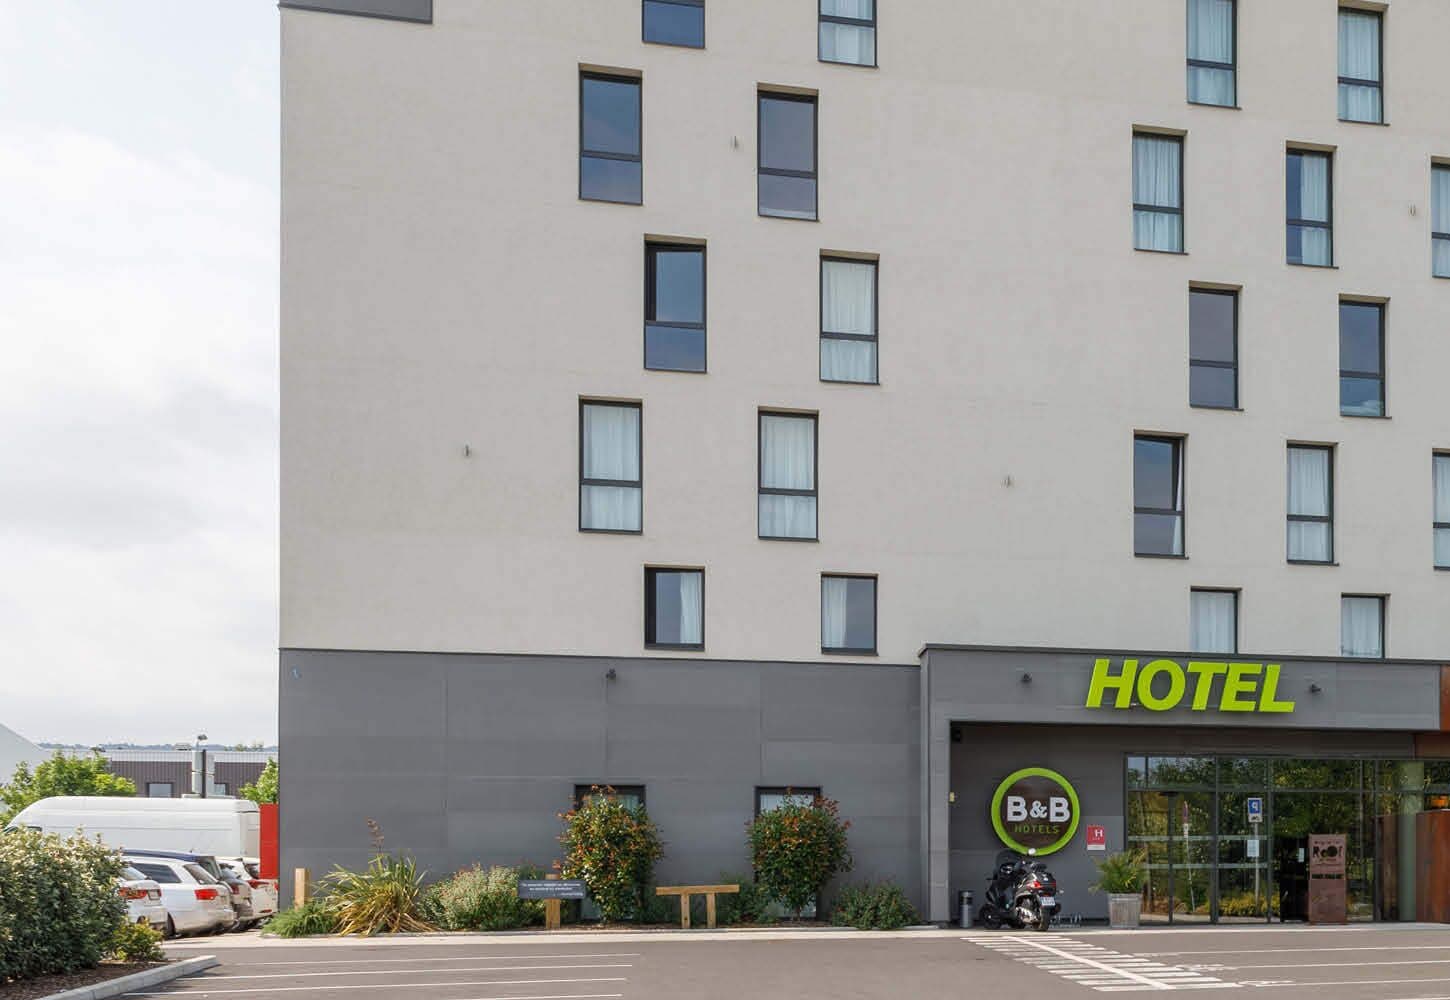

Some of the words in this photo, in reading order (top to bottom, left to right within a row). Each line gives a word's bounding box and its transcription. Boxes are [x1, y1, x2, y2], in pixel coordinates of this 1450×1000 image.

[1085, 658, 1296, 713] HOTEL
[1006, 795, 1071, 823] B&B
[1014, 823, 1061, 835] HOTELS
[1094, 829, 1104, 838] H
